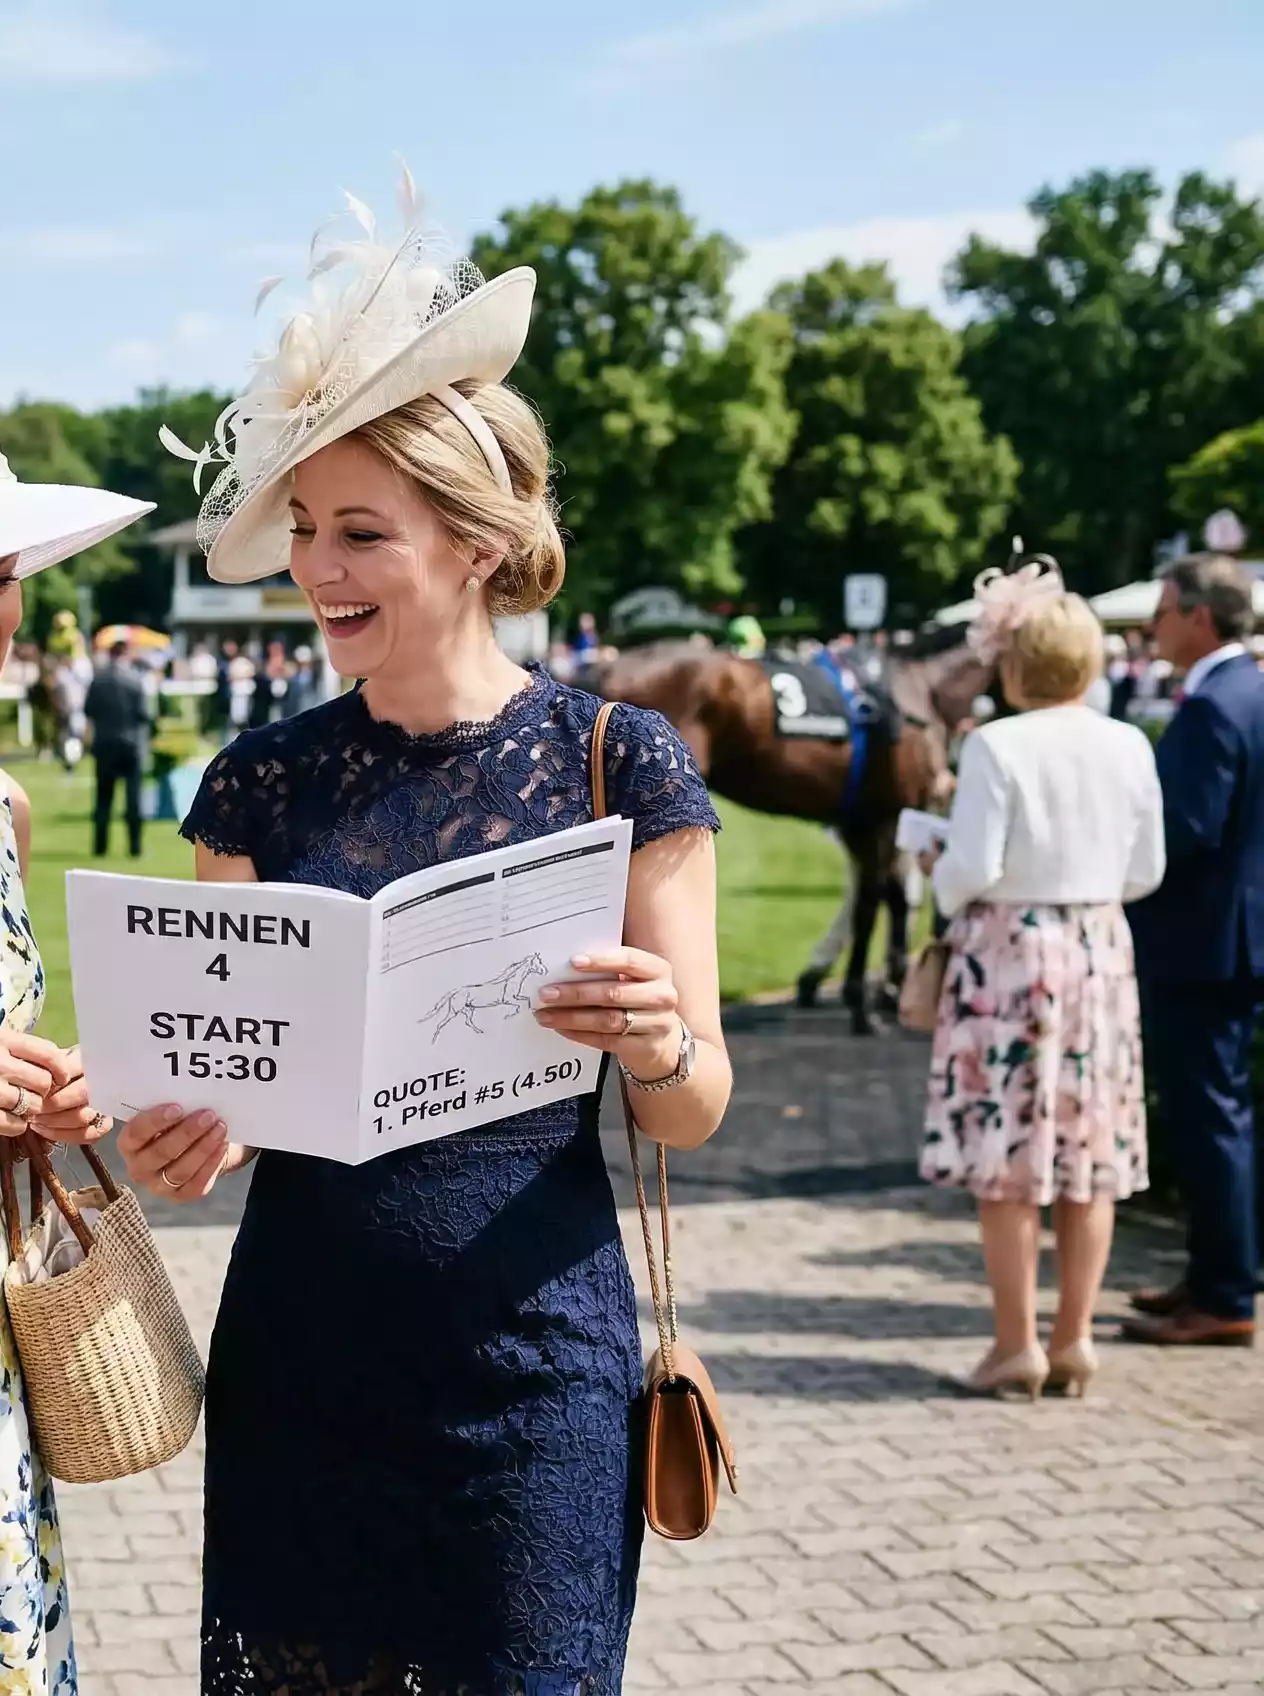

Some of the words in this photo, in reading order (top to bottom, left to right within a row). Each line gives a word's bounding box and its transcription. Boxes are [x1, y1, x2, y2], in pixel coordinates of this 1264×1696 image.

[770, 672, 807, 717] 3
[126, 904, 311, 948] RENNEN
[205, 953, 231, 982] 4
[149, 1011, 290, 1047] START
[163, 1051, 277, 1082] 15:30
[373, 1068, 466, 1108] QUOTE:
[373, 1116, 393, 1134] 1.
[402, 1091, 466, 1126] Pferd
[474, 1081, 504, 1104] #5
[513, 1058, 582, 1097] (4.50)
